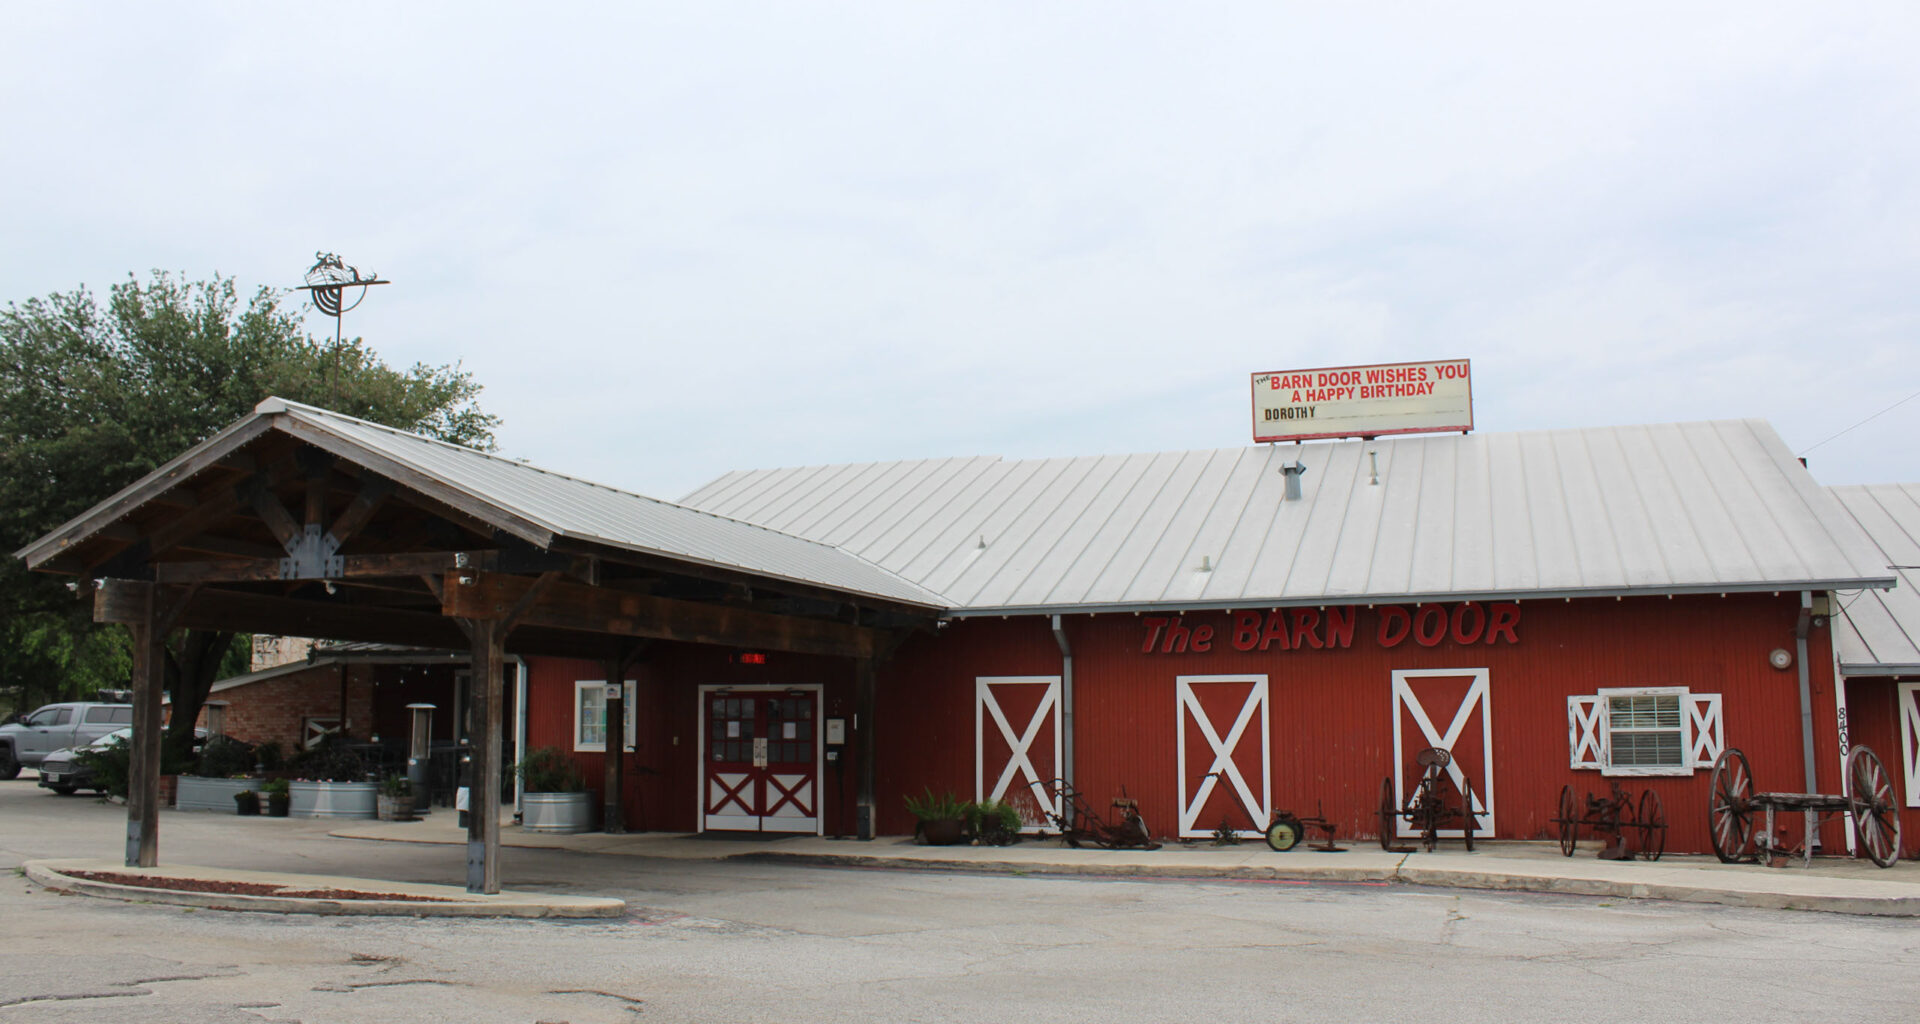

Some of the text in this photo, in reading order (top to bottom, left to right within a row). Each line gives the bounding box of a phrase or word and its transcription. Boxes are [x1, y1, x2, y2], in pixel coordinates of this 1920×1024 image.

[1255, 364, 1468, 390] THE BARN DOOR WISHES YOU
[1291, 381, 1435, 403] A HAPPY BIRTHDAY
[1265, 406, 1316, 421] DOROTHY
[1141, 600, 1521, 654] The BARN DOOR
[1838, 707, 1849, 756] 8400
